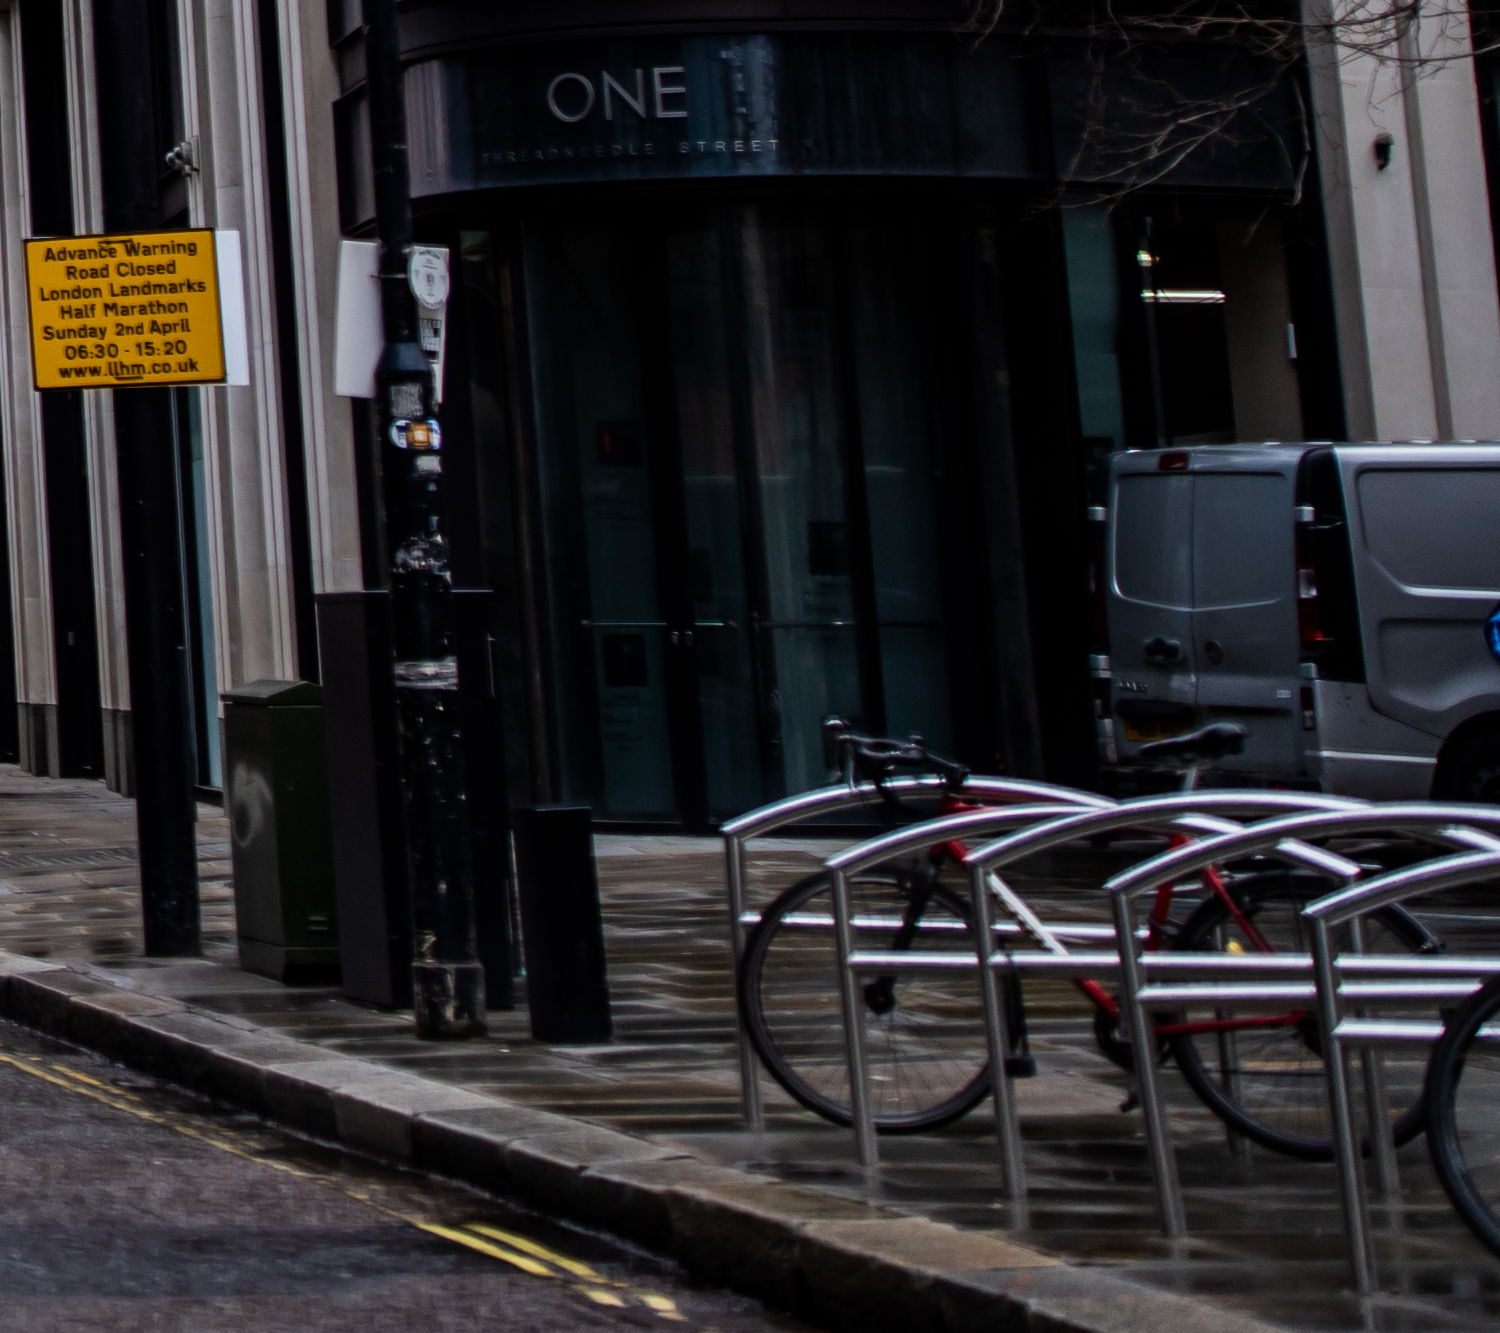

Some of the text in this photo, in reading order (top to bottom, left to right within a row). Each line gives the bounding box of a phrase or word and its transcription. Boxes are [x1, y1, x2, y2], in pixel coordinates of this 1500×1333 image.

[547, 66, 689, 124] ONE
[482, 139, 781, 164] THREADNEEDLE STREET
[44, 239, 198, 263] Advance Warning
[66, 260, 177, 281] Road Closed
[40, 279, 207, 302] London Landmarks
[60, 300, 189, 320] Half Marathon
[42, 319, 192, 342] Sunday 2nd April
[64, 343, 119, 360] 06:30
[135, 339, 188, 357] 15:20
[58, 358, 199, 379] www.llhm.co.uk
